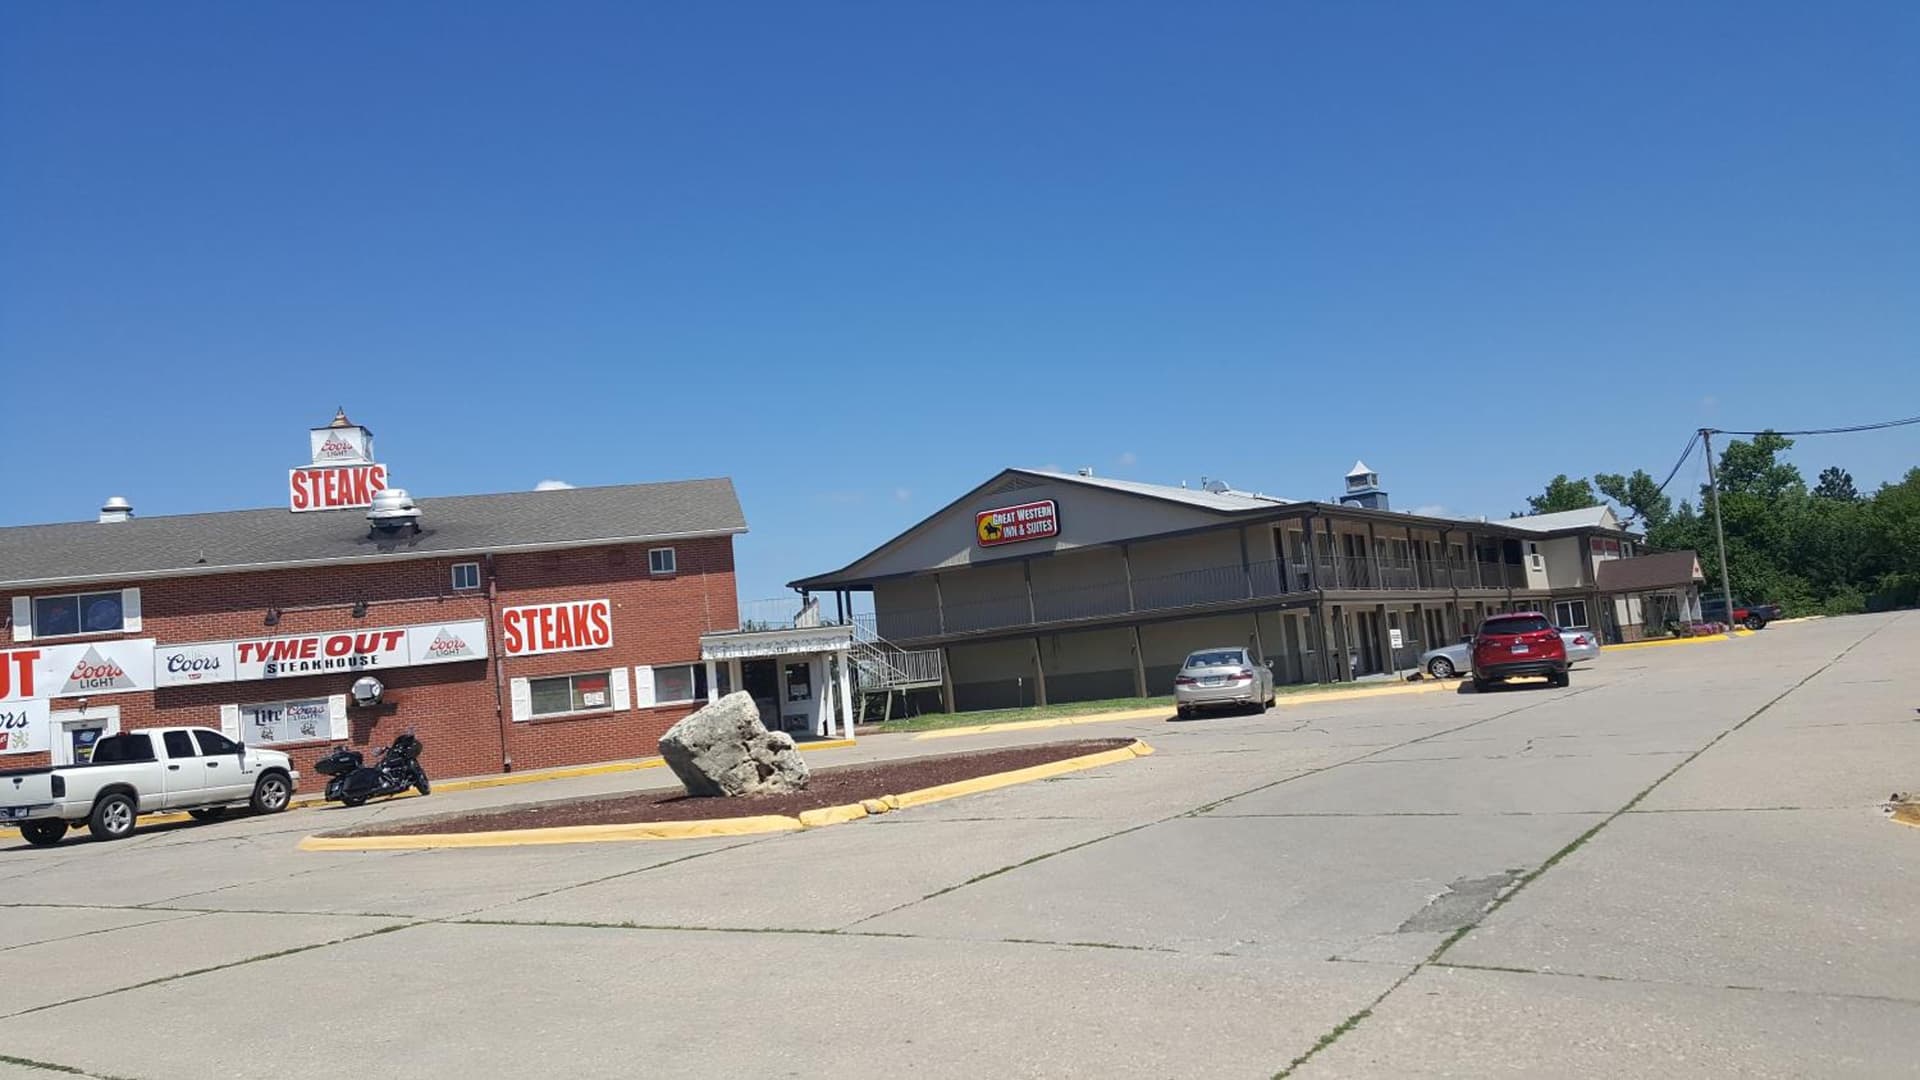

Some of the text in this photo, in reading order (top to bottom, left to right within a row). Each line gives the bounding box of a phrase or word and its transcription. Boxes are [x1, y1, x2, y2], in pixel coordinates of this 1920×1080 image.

[291, 466, 385, 509] STEAKS
[1026, 520, 1053, 534] SUITES
[503, 602, 610, 653] STEAKS
[237, 630, 405, 664] TYME OUT
[430, 636, 466, 650] Coors
[436, 648, 459, 656] LIGHT
[70, 660, 124, 680] Coors
[167, 653, 220, 672] Coors
[266, 654, 379, 674] STEAKHOUSE
[80, 677, 115, 689] LIGHT
